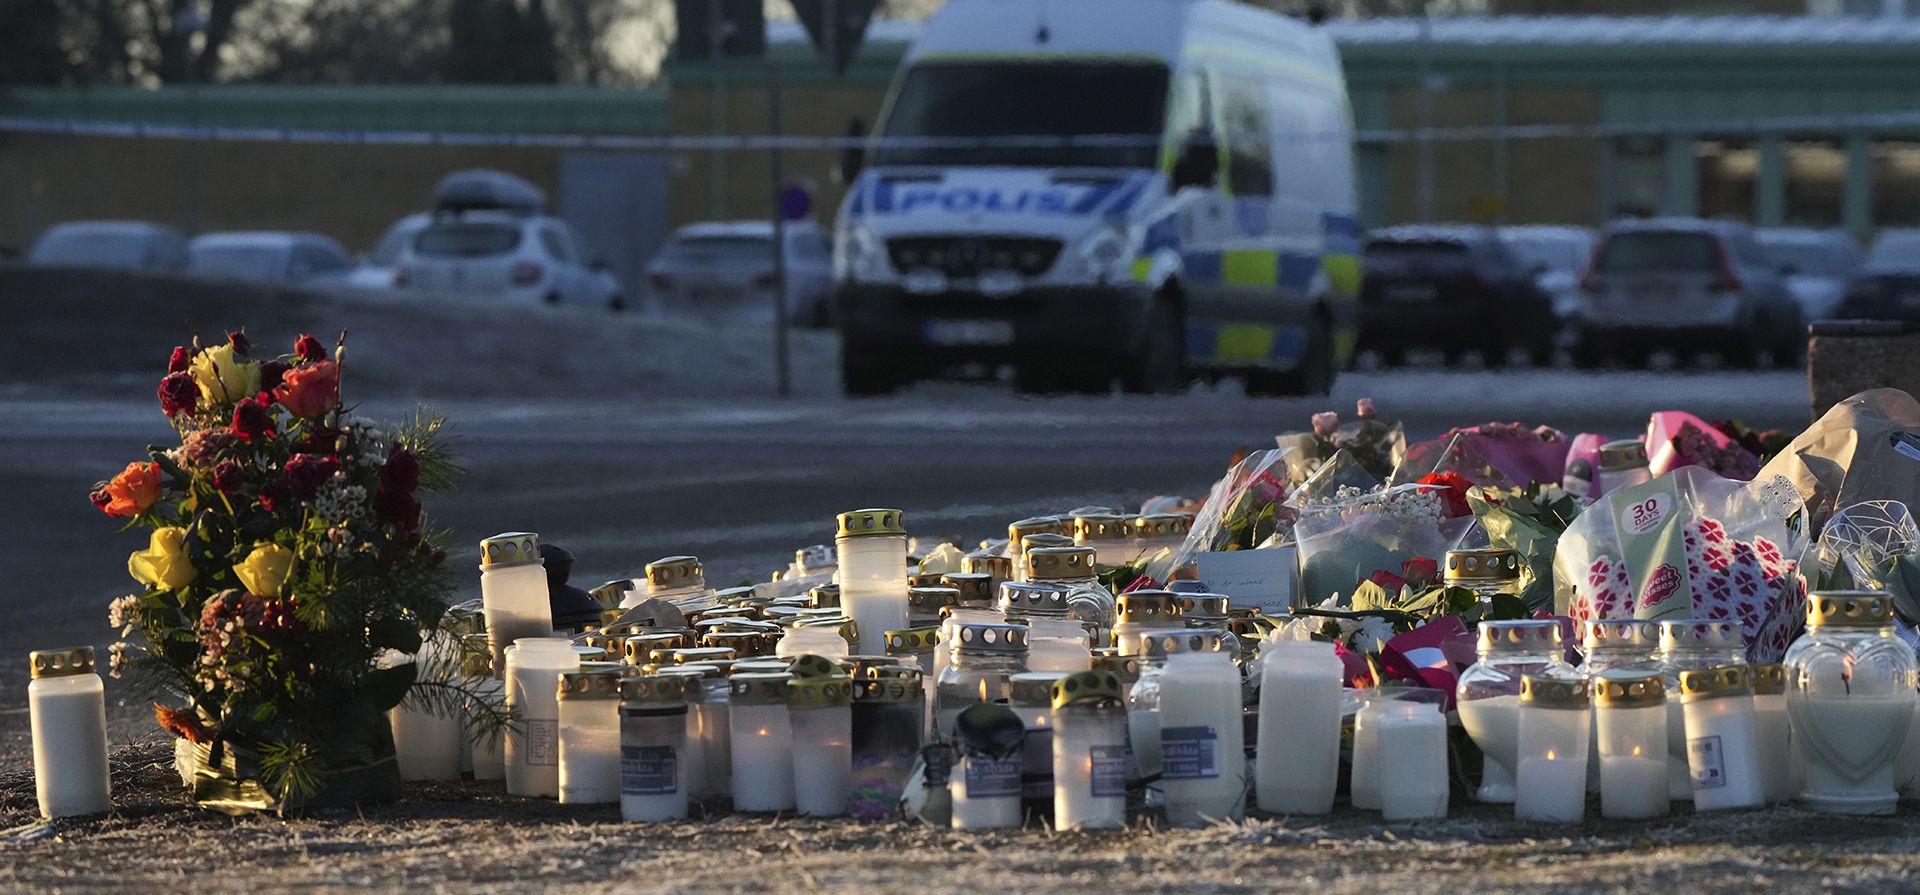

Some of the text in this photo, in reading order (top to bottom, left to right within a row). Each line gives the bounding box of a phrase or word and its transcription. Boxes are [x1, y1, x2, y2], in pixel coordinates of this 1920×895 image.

[901, 186, 1068, 213] POLIS
[1632, 499, 1657, 519] 30
[1634, 509, 1660, 526] DAYS
